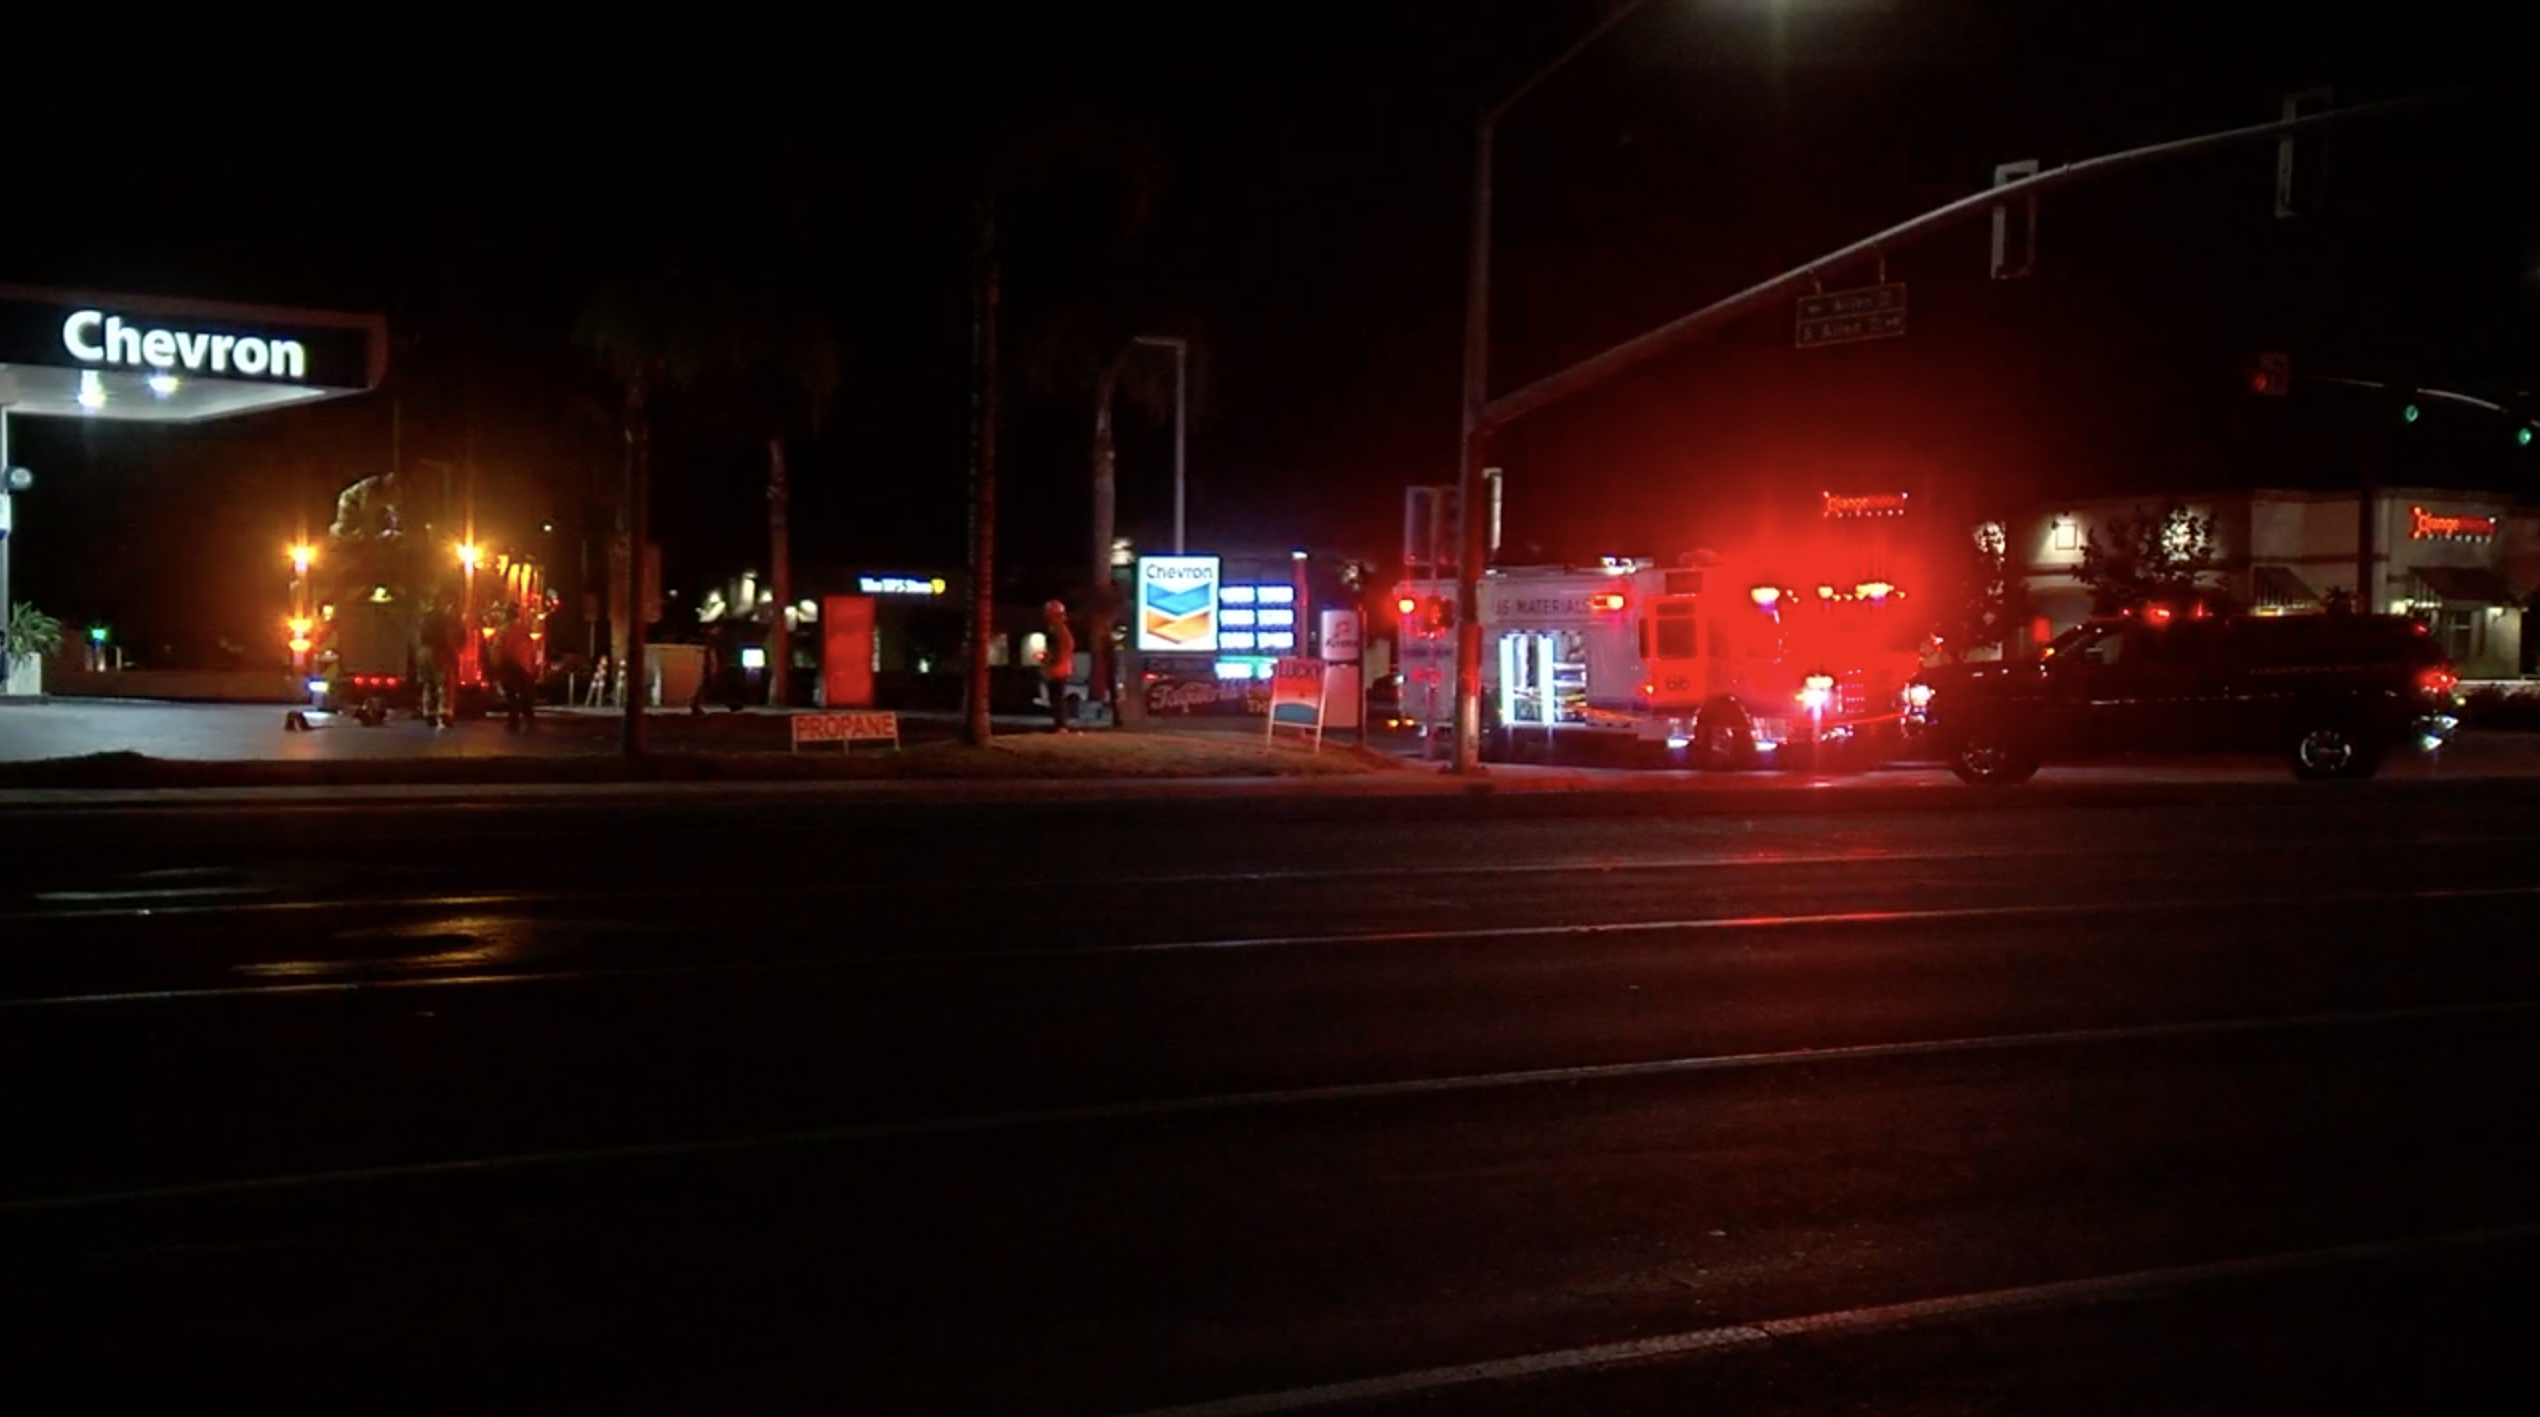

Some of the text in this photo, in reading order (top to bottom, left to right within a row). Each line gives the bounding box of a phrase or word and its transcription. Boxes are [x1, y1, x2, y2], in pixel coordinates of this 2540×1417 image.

[63, 310, 305, 377] Chevron
[1146, 563, 1214, 579] Chevron
[1517, 599, 1590, 616] MATERIALS
[796, 714, 895, 740] PROPANE
